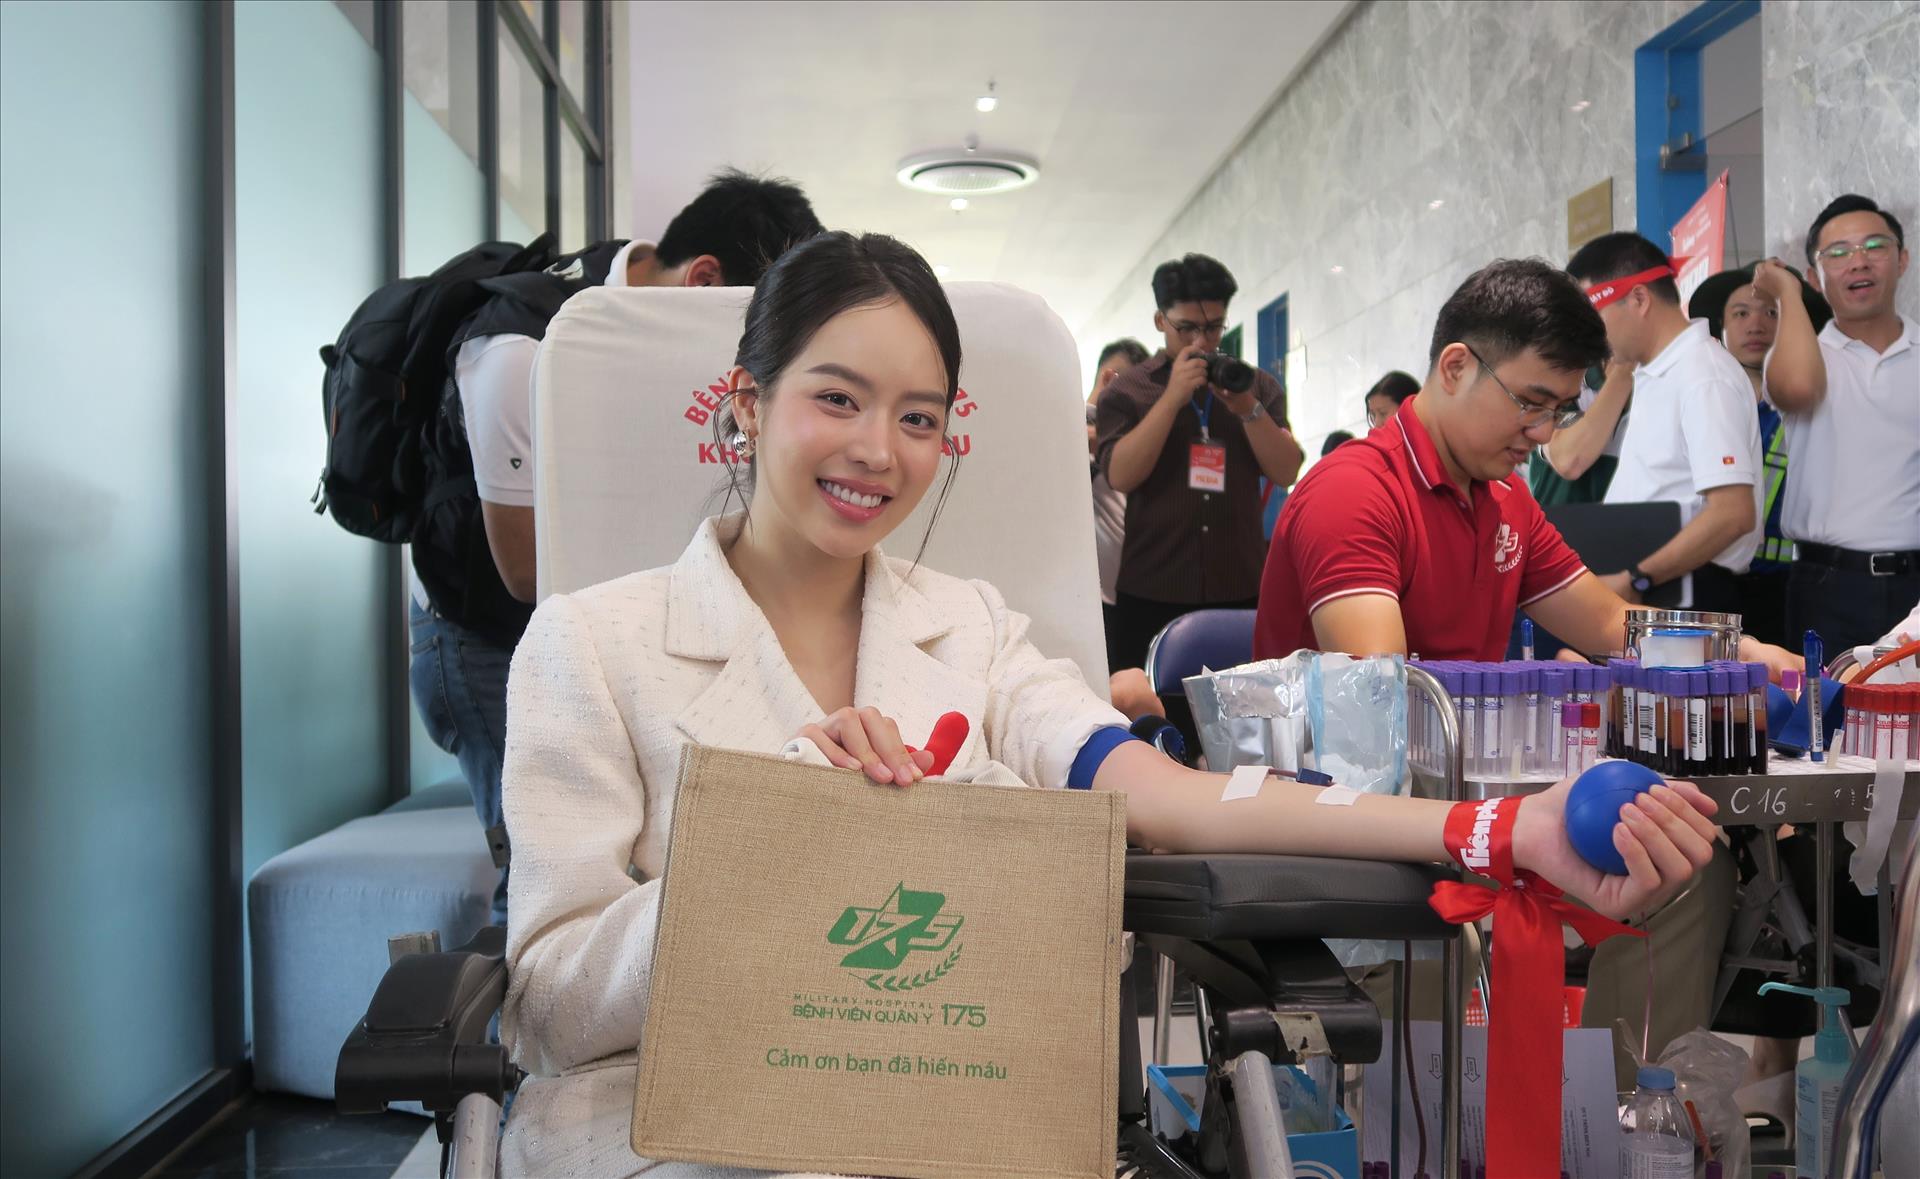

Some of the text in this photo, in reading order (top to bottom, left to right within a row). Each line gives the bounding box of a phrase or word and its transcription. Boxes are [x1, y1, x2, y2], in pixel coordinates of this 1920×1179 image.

[794, 993, 933, 1009] MILITARY HOSPITAL
[793, 1003, 987, 1028] BỆNH VIỆN QUÂN Y 175
[766, 1048, 1007, 1079] Cảm ơn bạn đã hiến máu
